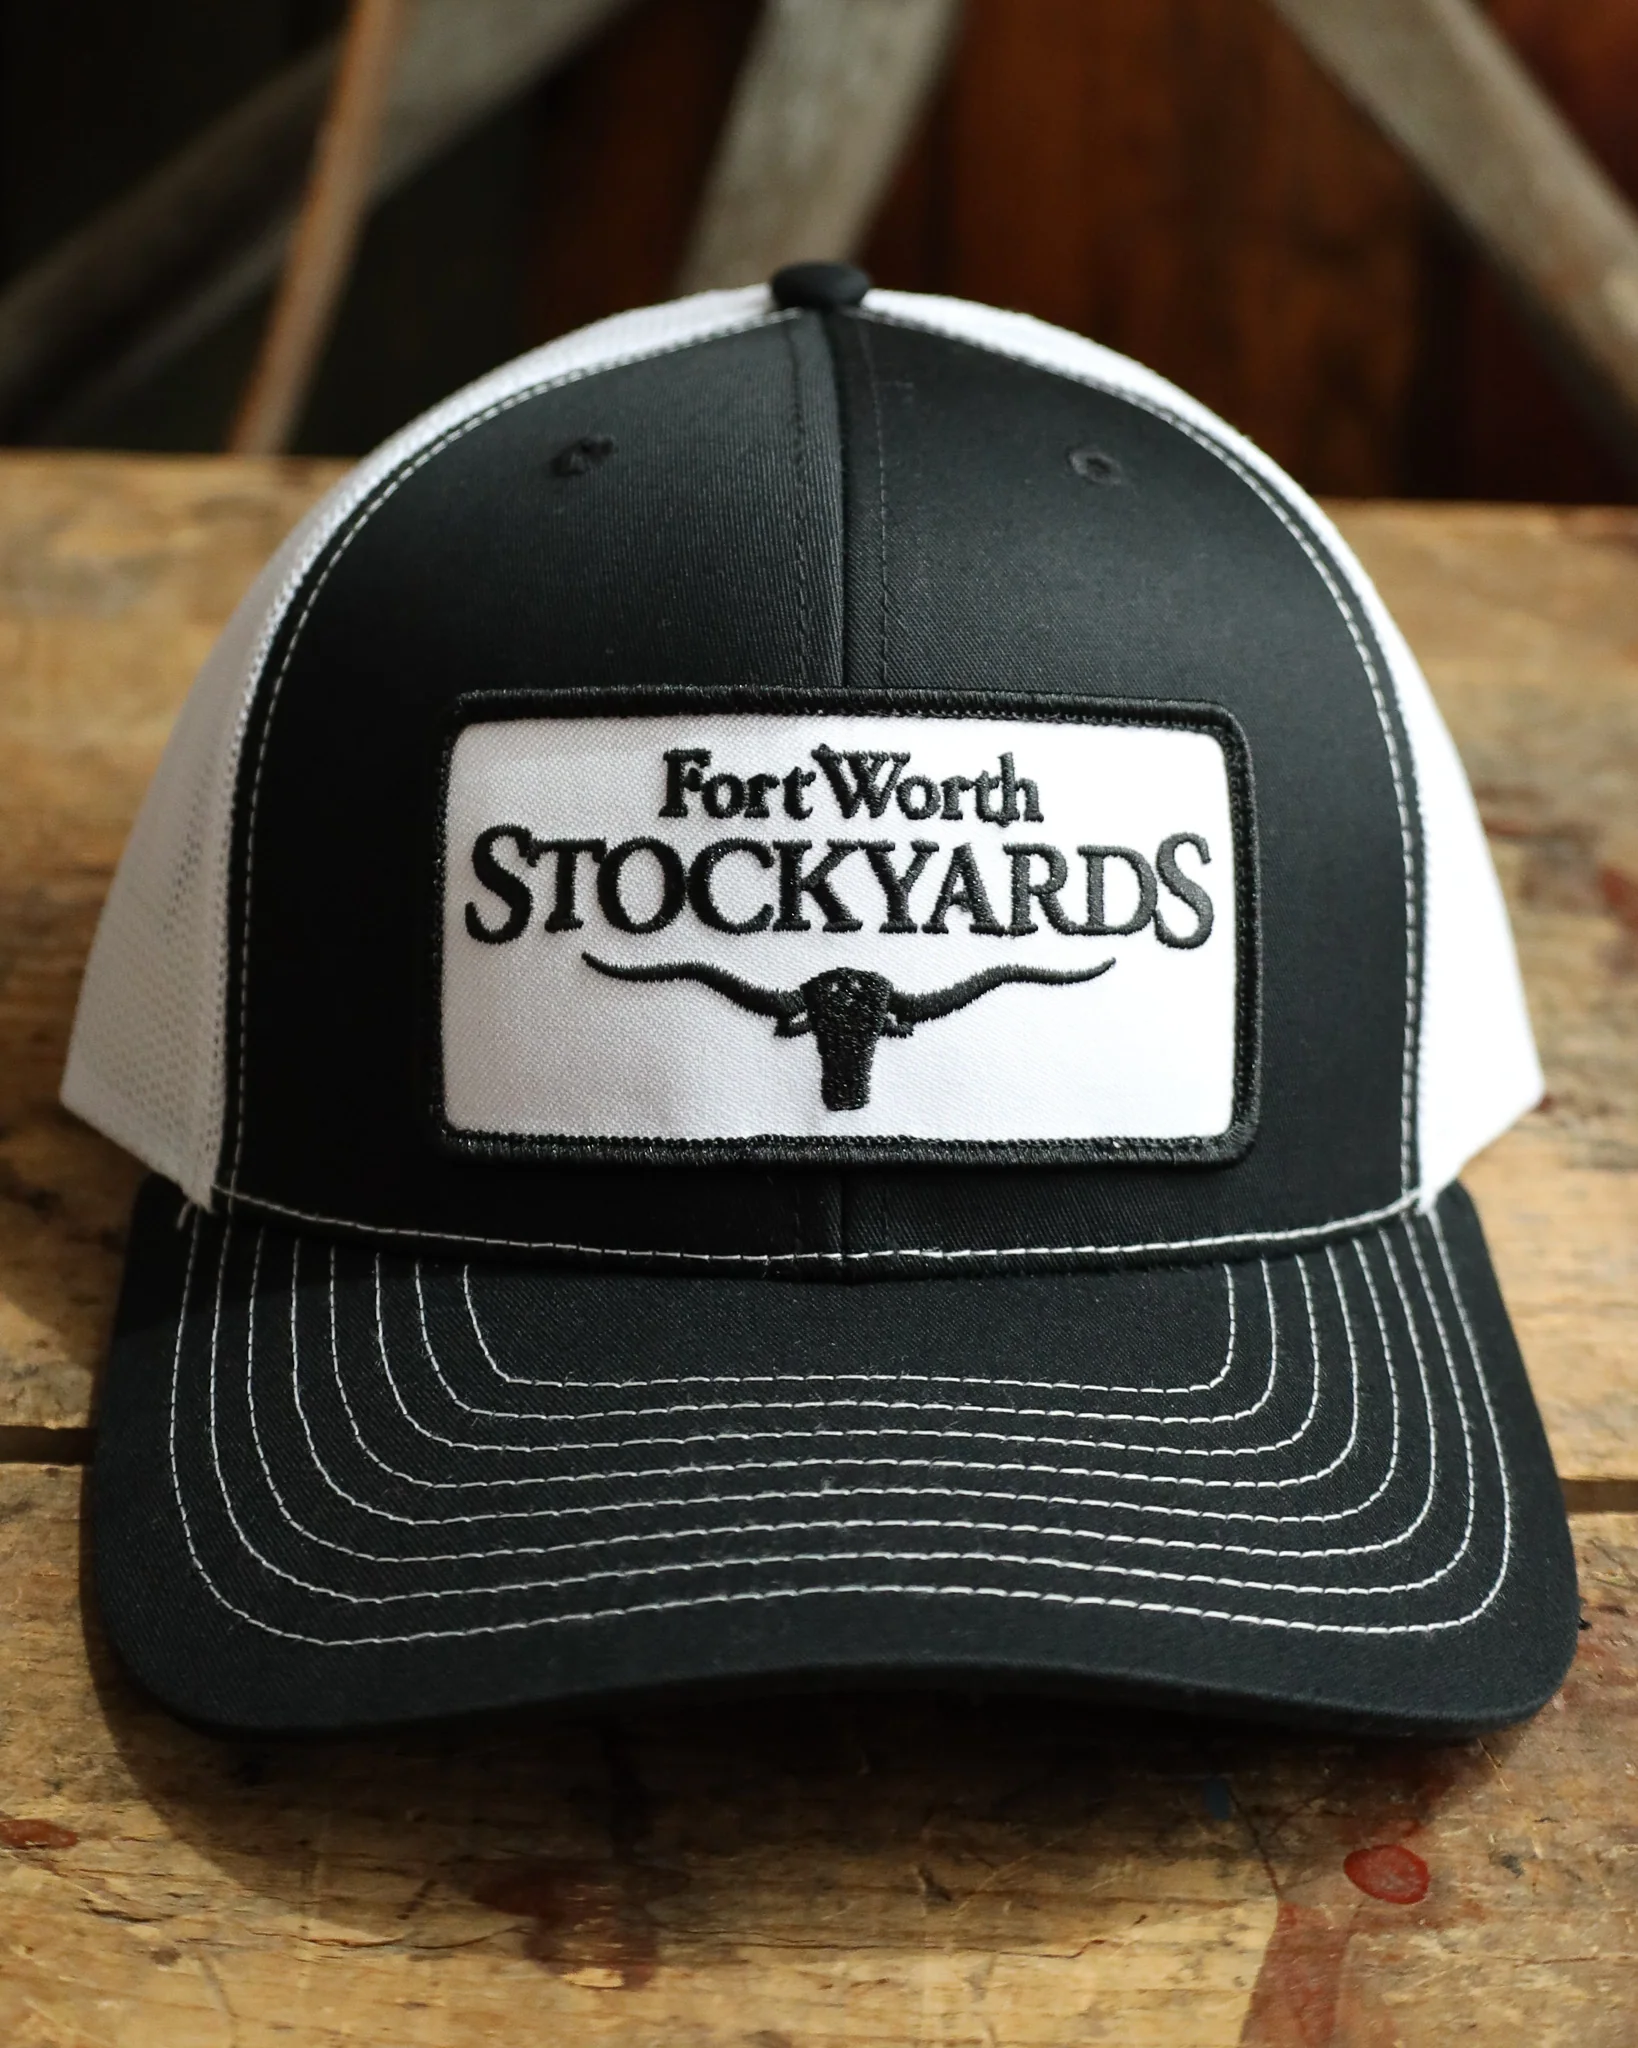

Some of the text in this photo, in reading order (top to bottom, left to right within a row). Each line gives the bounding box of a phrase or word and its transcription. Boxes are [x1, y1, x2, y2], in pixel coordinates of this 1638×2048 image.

[658, 743, 1044, 827] Fort Worth
[464, 823, 1214, 950] STOCKYARDS
